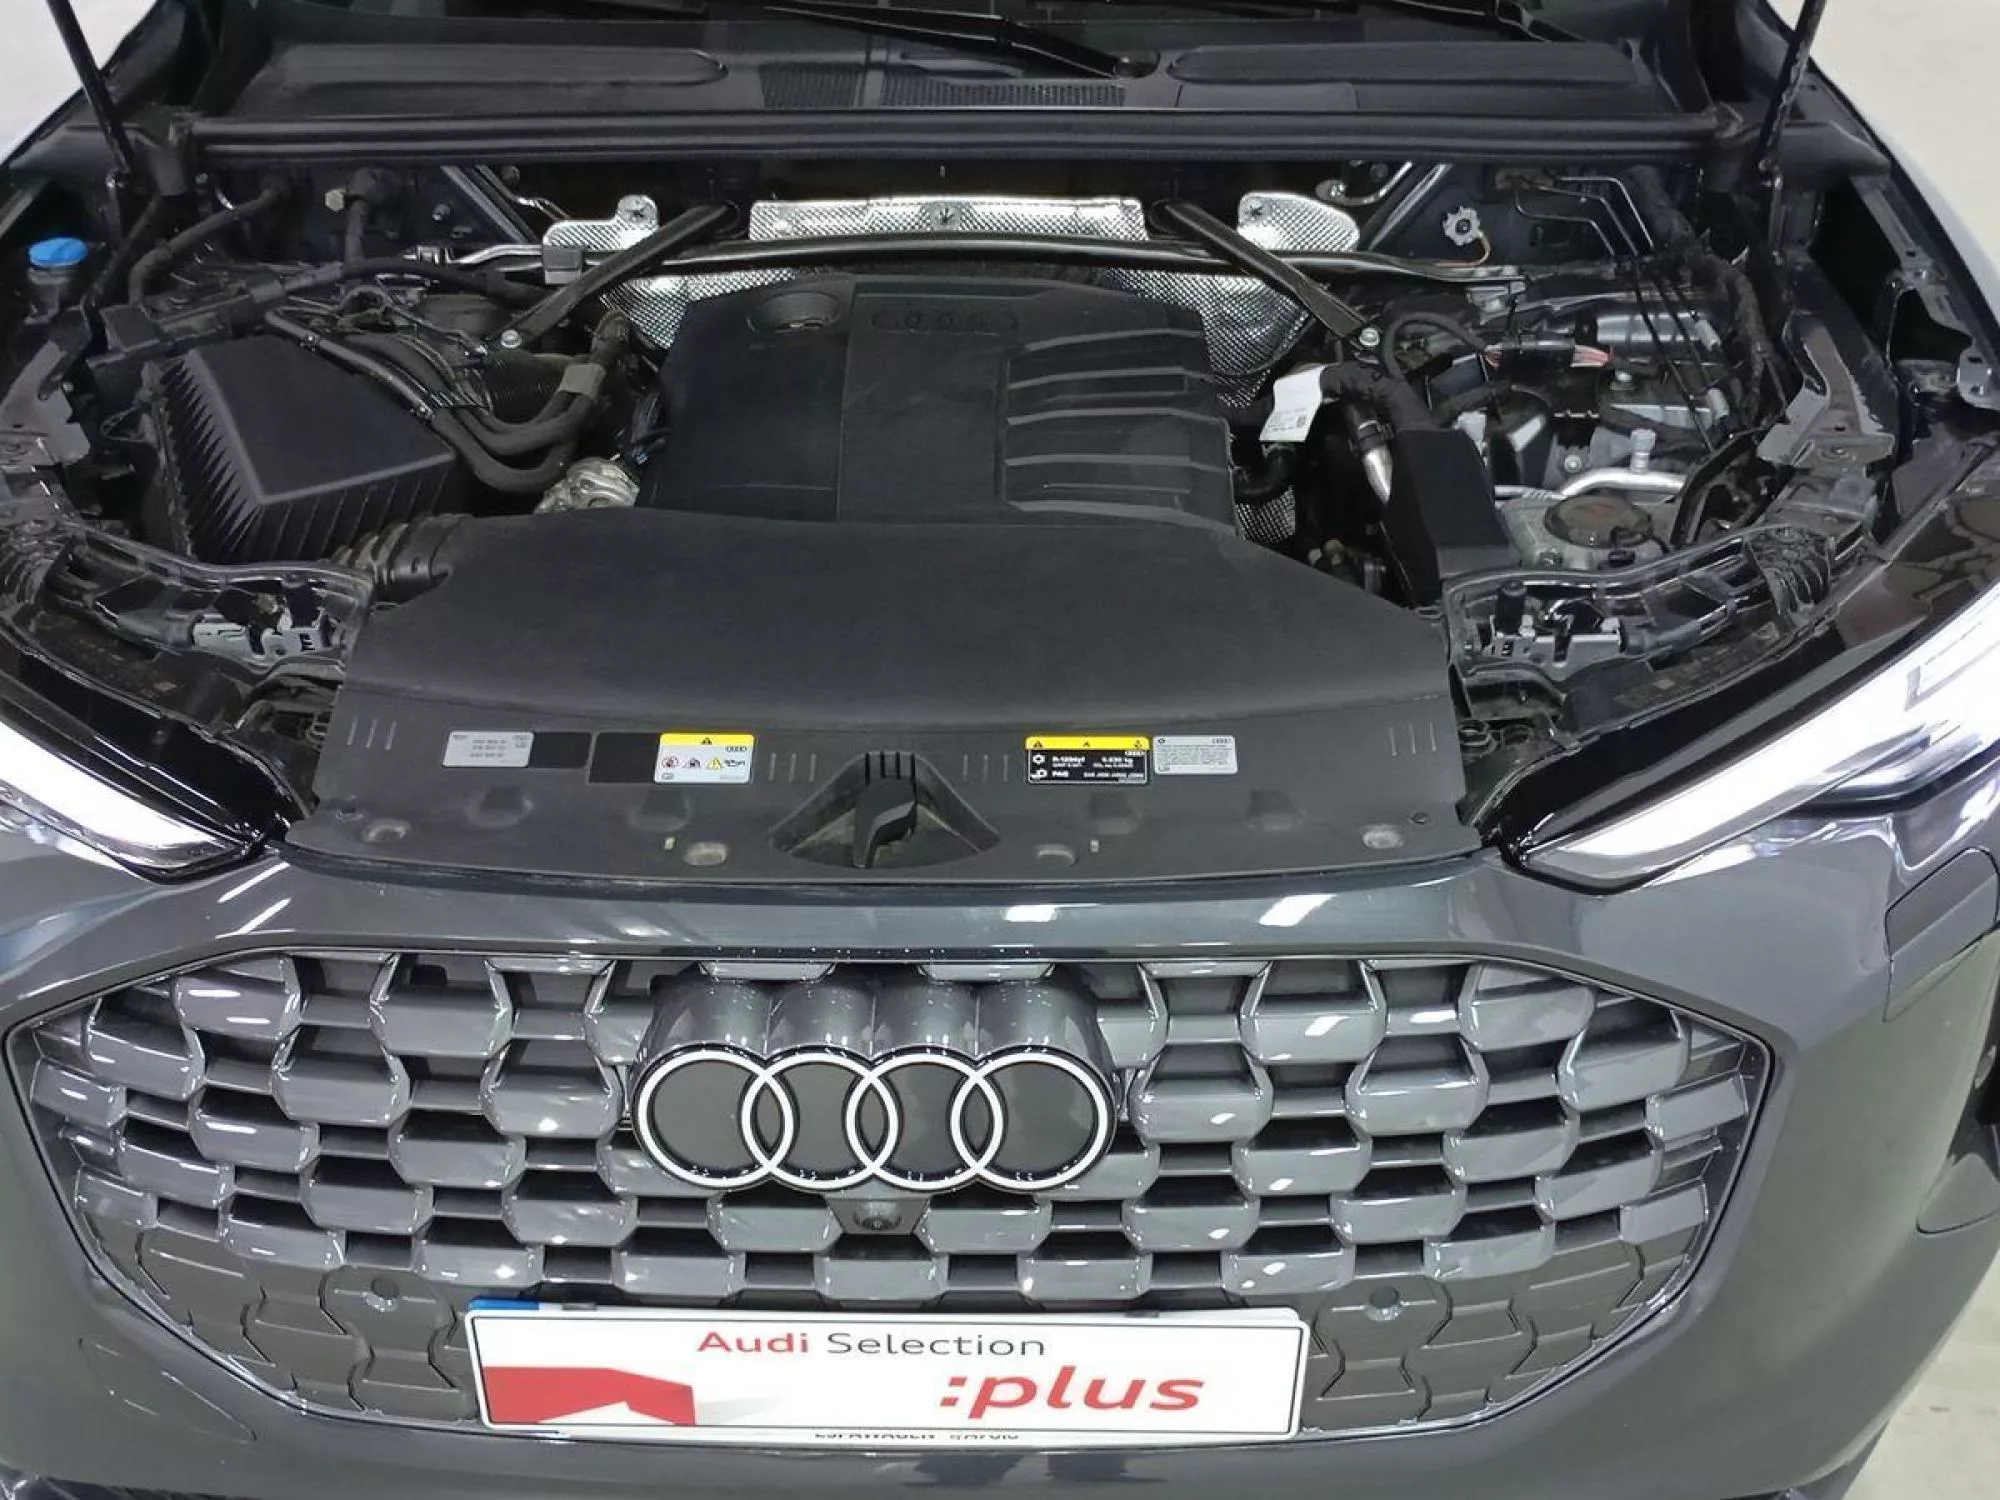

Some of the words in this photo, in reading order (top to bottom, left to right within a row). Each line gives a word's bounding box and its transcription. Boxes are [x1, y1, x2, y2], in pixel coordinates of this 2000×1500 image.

[698, 1331, 808, 1353] Audi
[827, 1331, 1045, 1356] Selection
[941, 1366, 1204, 1420] :plus
